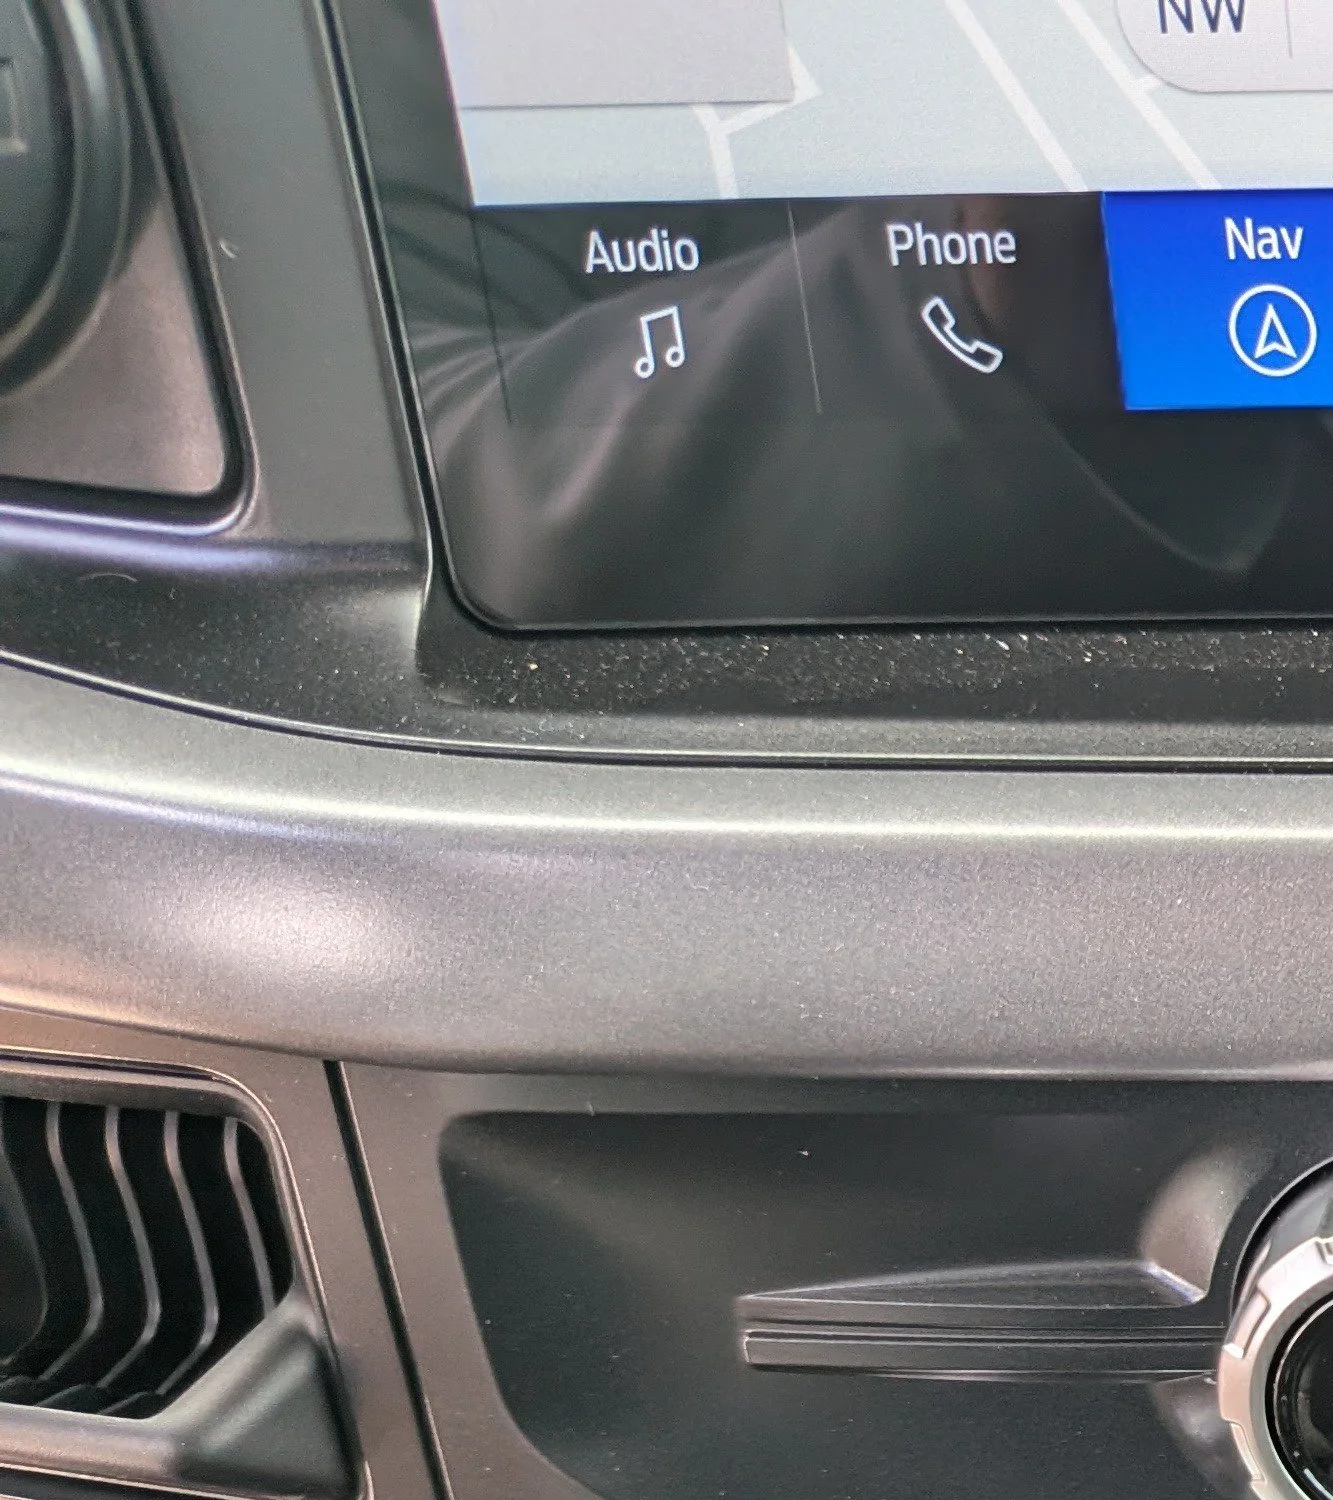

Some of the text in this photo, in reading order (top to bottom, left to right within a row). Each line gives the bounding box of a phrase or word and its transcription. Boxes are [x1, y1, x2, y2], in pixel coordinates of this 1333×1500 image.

[1157, 0, 1245, 34] NW
[584, 226, 700, 275] Audio
[886, 222, 1017, 267] Phone
[1224, 216, 1304, 261] Nav
